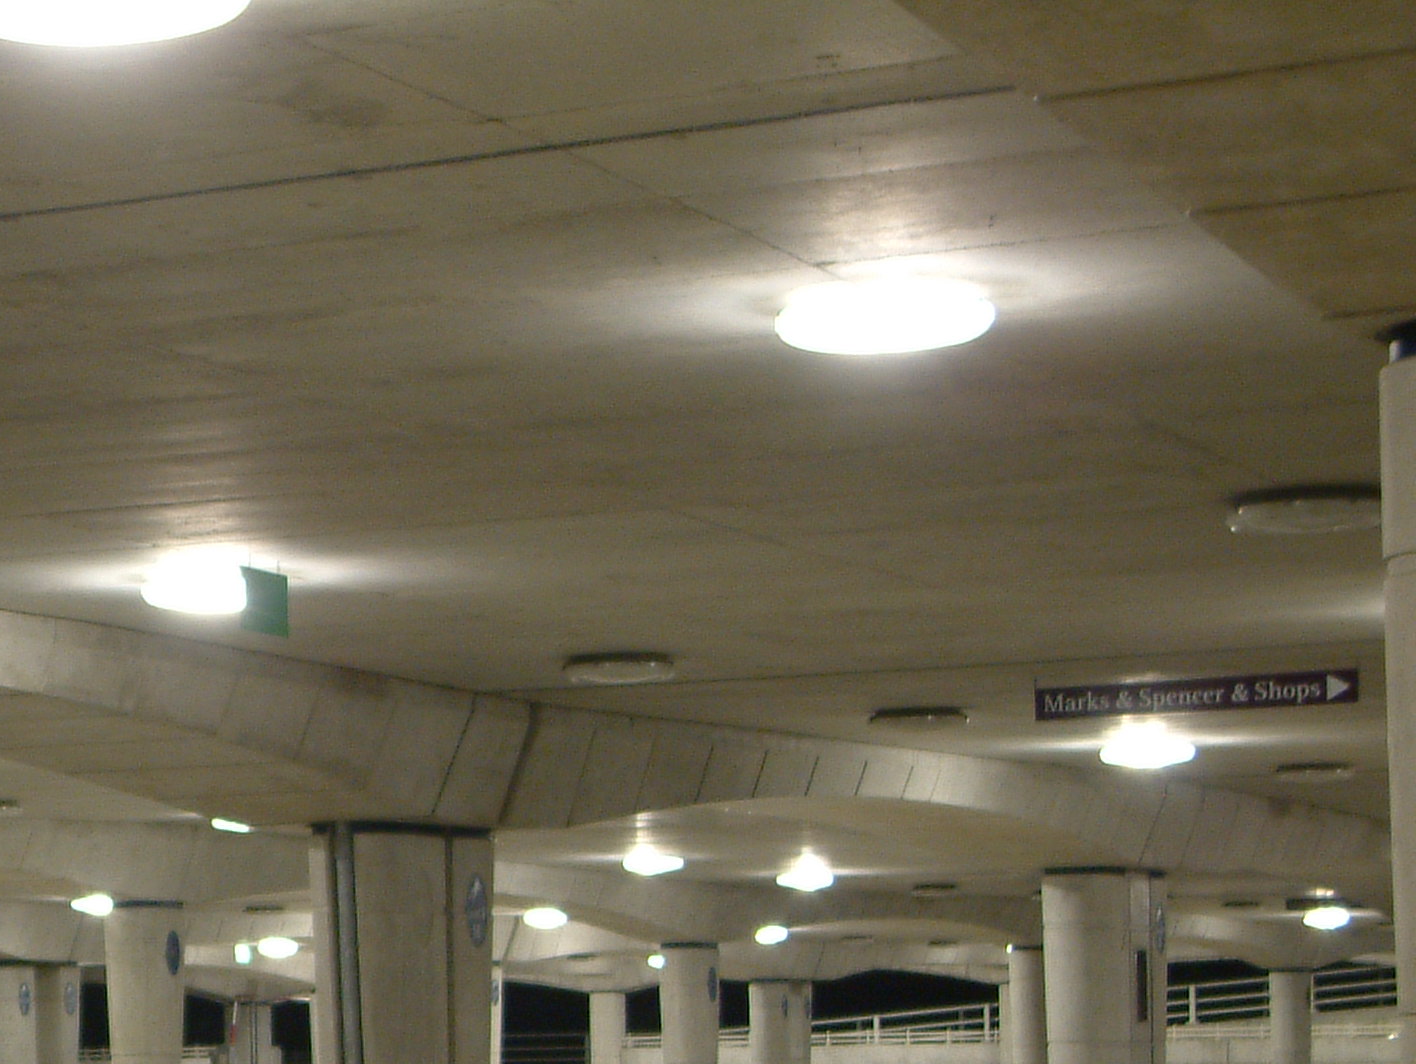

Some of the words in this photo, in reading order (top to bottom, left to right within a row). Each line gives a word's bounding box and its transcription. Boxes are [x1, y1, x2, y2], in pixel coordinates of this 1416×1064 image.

[1044, 690, 1109, 714] Marks
[1115, 690, 1134, 709] &
[1138, 686, 1225, 712] Spencer
[1230, 683, 1249, 703] &
[1254, 679, 1321, 704] Shops
